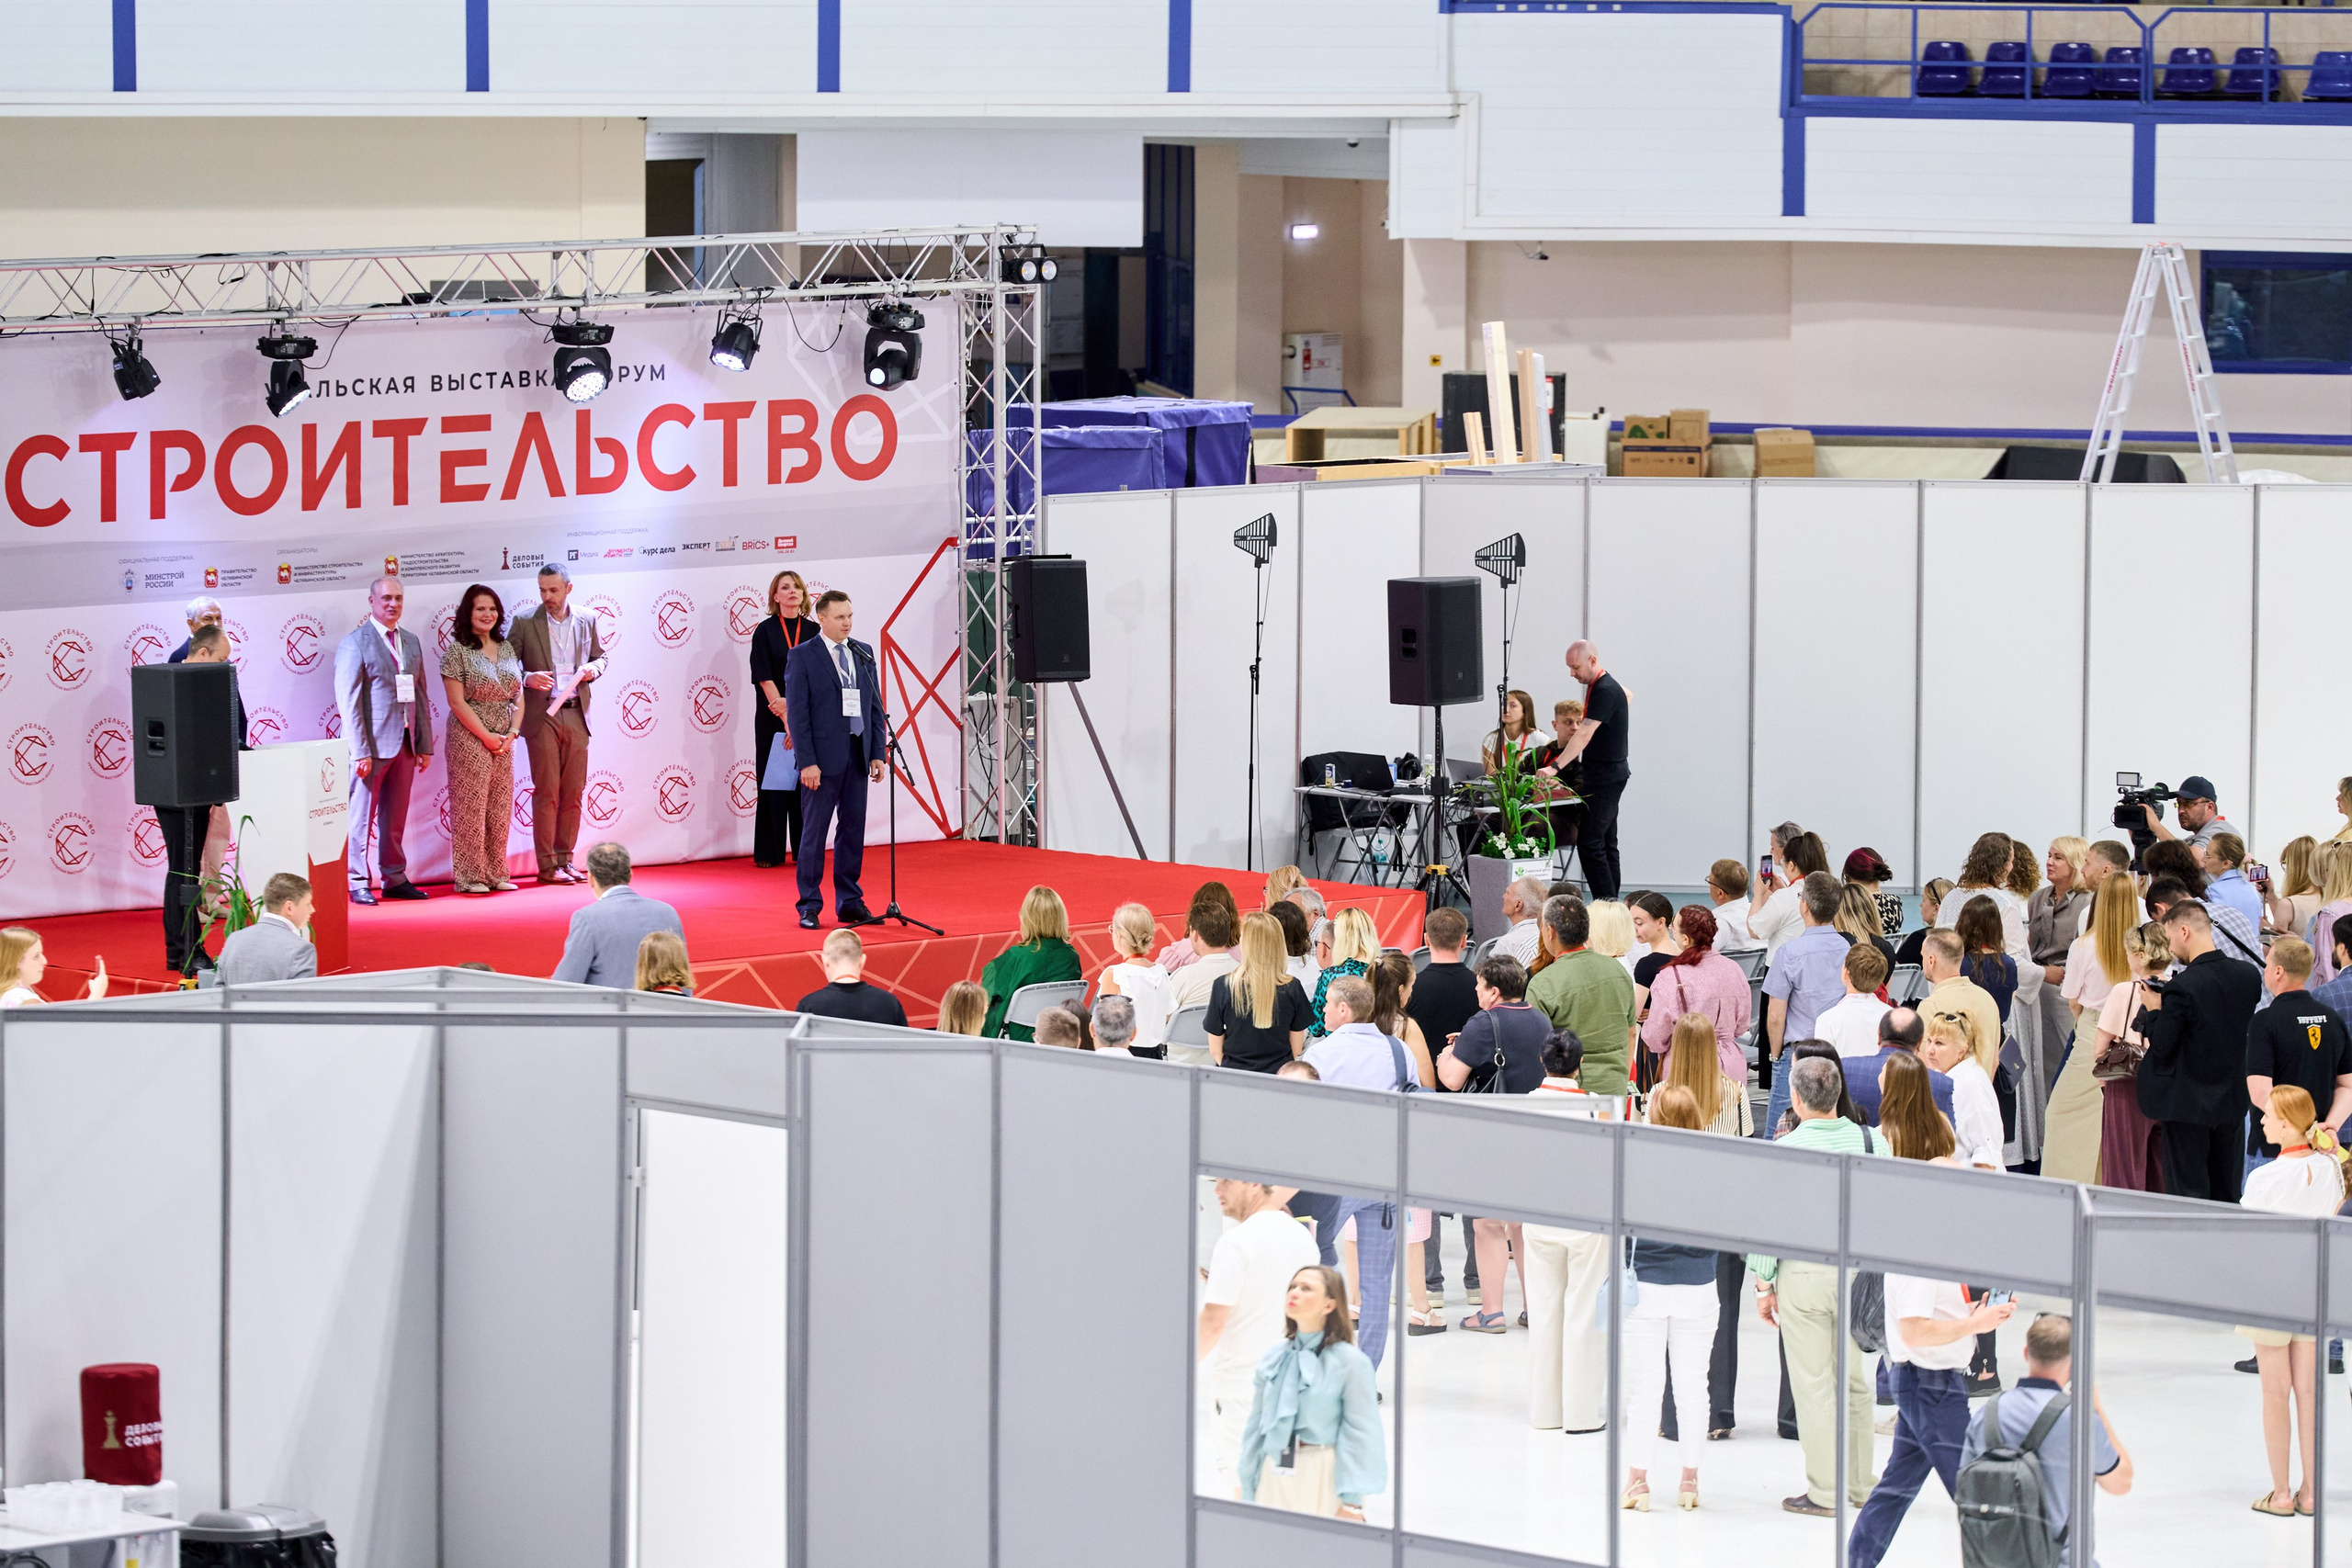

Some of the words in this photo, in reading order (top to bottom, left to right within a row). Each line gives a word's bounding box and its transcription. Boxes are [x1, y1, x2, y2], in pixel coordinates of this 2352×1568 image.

[430, 364, 665, 393] ВЫСТАВКРУМ
[5, 394, 899, 527] СТРОИТЕЛЬСТВО
[512, 553, 545, 562] ДЕЛОВЫЕ
[660, 547, 676, 555] дела
[682, 542, 710, 550] ЭКСПЕРТ
[144, 570, 185, 581] МИНСТРОЙ
[512, 560, 545, 570] СОБЫТИЯ
[144, 581, 175, 589] РОССИИ
[722, 584, 766, 610] СТРОИТЕЛЬСТВО
[504, 598, 538, 625] СТРОИТЕЛЬ
[584, 593, 623, 617] ОИТЕЛЬСТВО
[650, 589, 695, 615] СТРОИТЕЛЬСТВО
[123, 623, 172, 650] СТРОИТЕЛЬСТВО
[223, 618, 250, 642] ЕЛЬСТВО
[278, 613, 326, 640] СТРОИТЕЛЬСТВО
[45, 628, 93, 655] СТРОИТЕЛЬСТВО
[615, 679, 660, 705] СТРОИТЕЛЬСТВО
[686, 674, 731, 700] СТРОИТЕЛЬСТВО
[6, 722, 55, 750] СТРОИТЕЛЬСТВО
[85, 716, 134, 744] СТРОИТЕЛЬСТВО
[652, 763, 696, 790] СТРОИТЕЛЬСТВО
[724, 759, 755, 784] СТРОИТЕЛЬ
[126, 806, 153, 832] СТРОИТЕ
[309, 802, 348, 819] СТРОИТЕЛЬСТВО
[47, 811, 96, 839] СТРОИТЕЛЬСТВО
[2297, 1015, 2328, 1024] Ferrari
[124, 1421, 163, 1437] ДЕЛОВ
[124, 1433, 162, 1448] СОБЫТ
